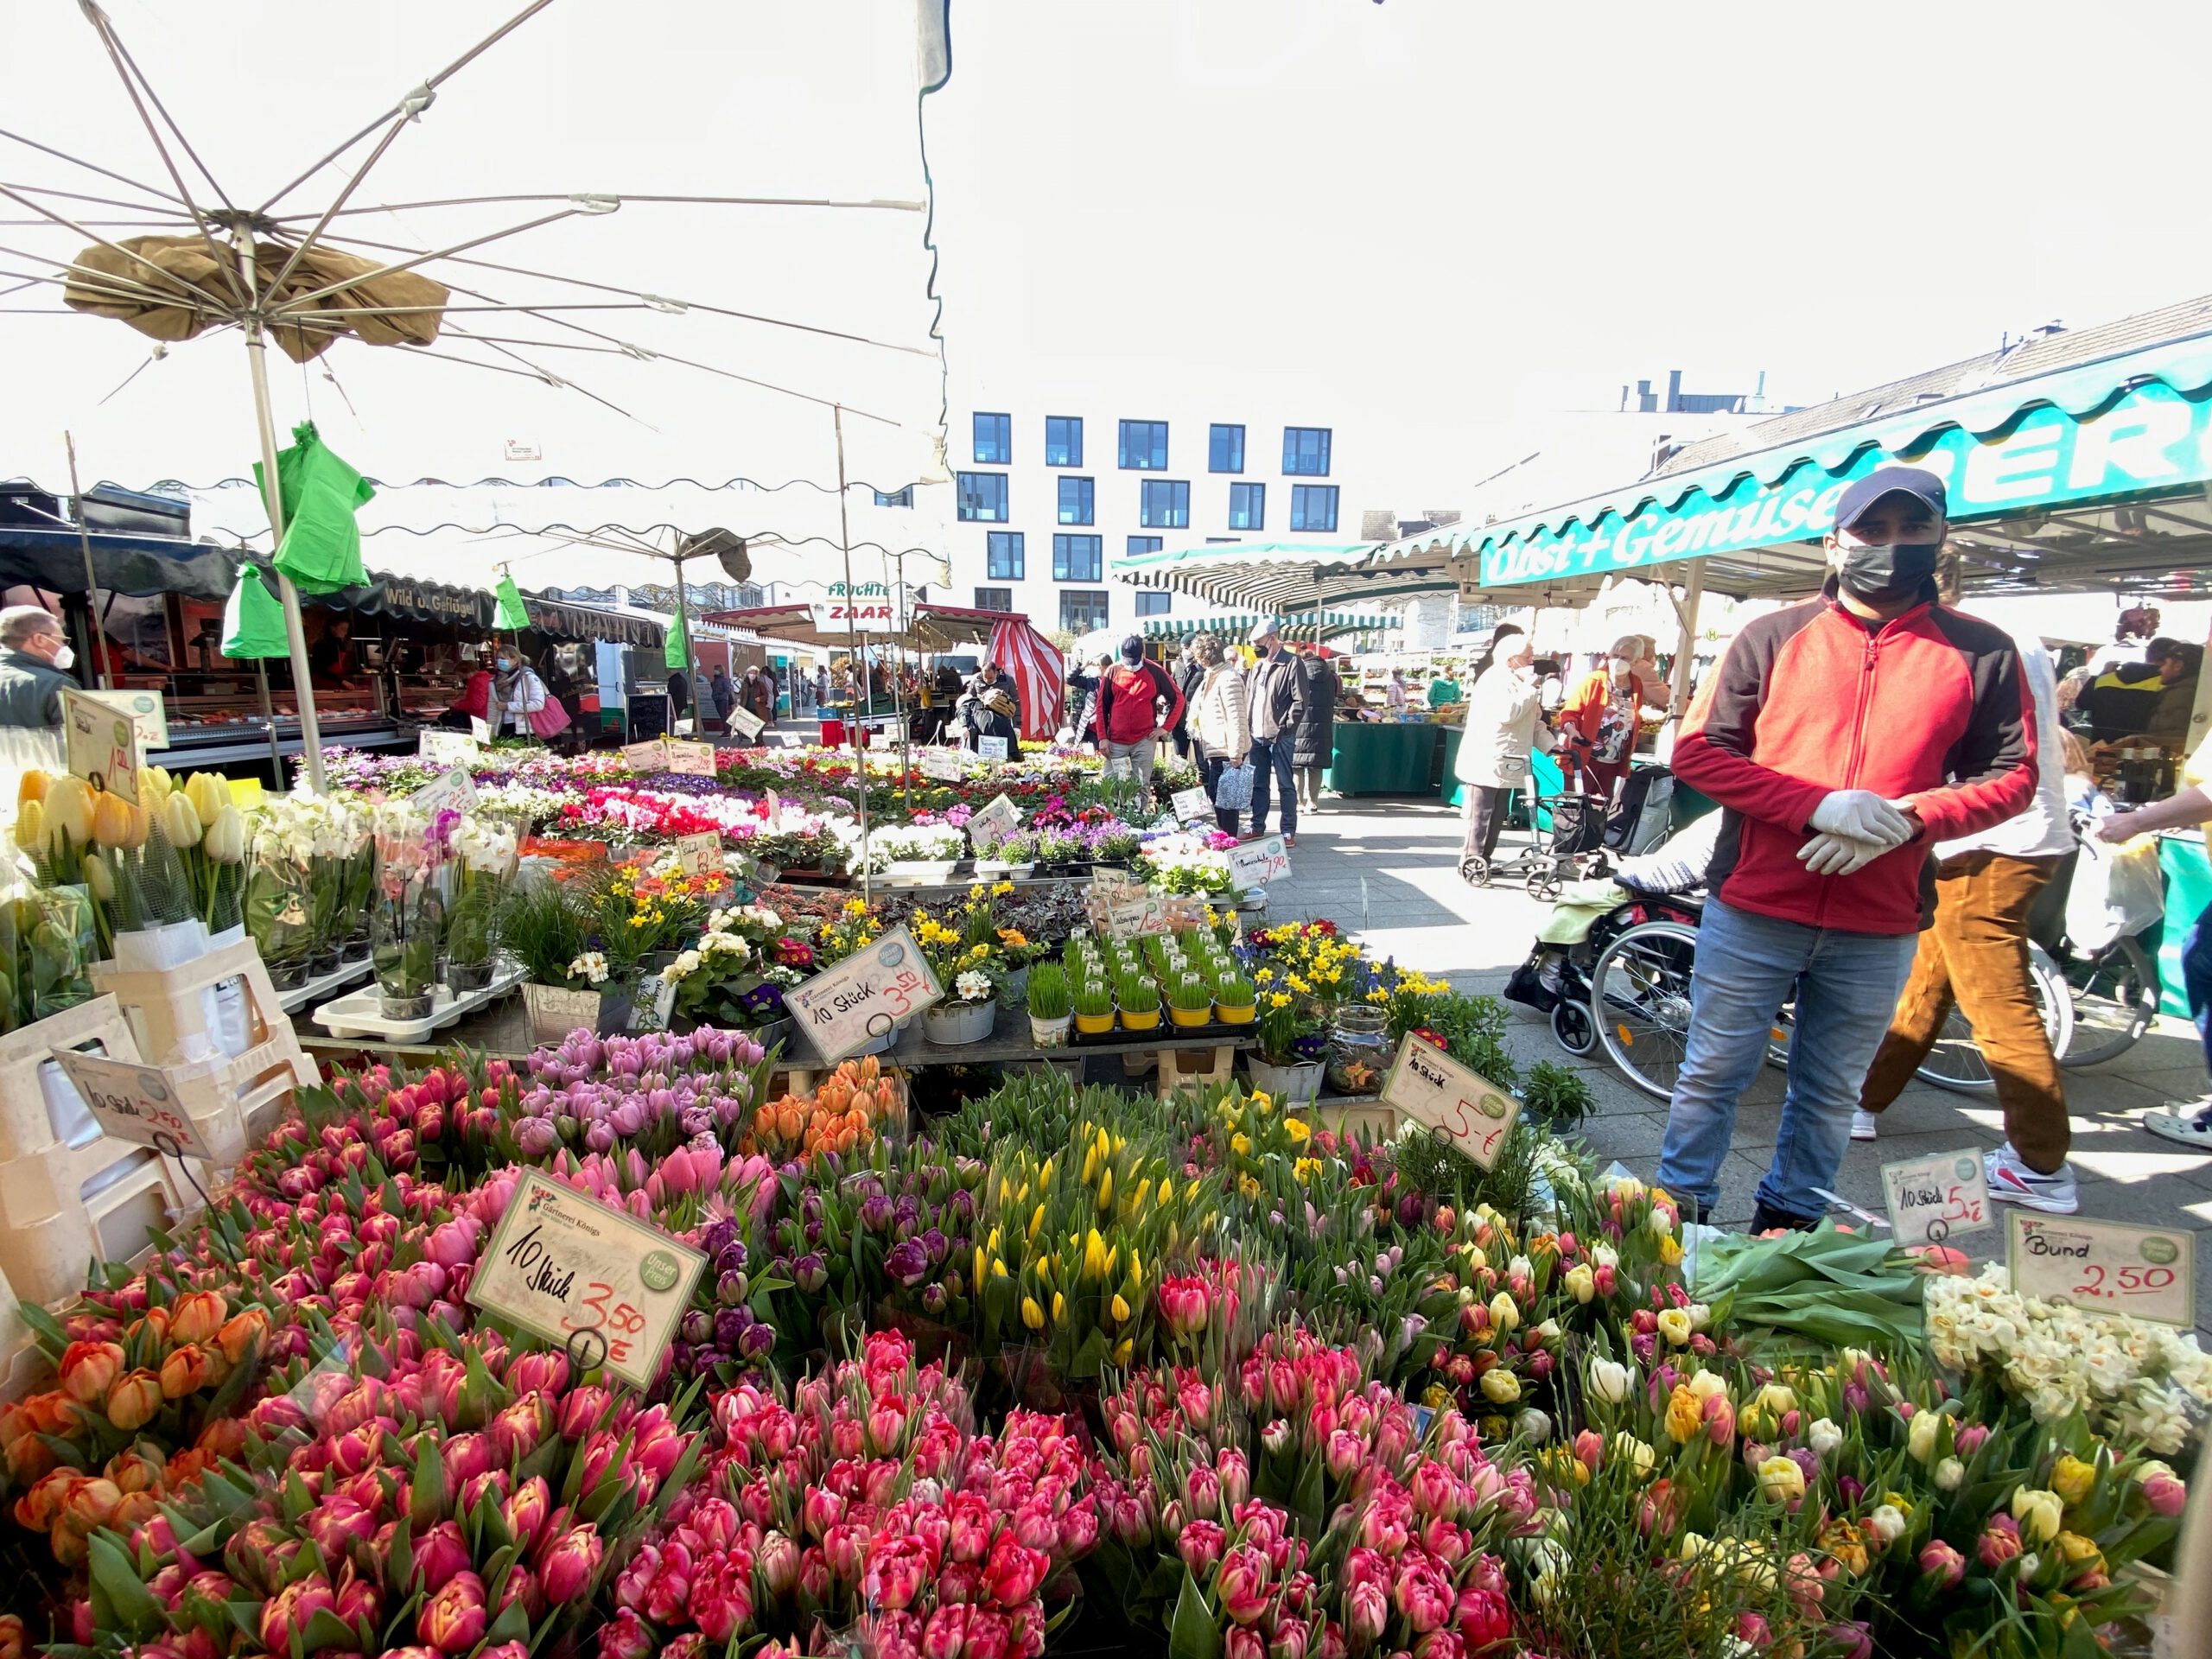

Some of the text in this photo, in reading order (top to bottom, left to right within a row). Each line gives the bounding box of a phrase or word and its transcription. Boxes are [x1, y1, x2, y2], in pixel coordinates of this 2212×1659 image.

[385, 588, 413, 607] Wild
[432, 595, 474, 619] Geflügel
[830, 607, 893, 619] ZAAR
[812, 982, 876, 1025] 10 Stück
[1408, 1058, 1446, 1089] 10 Stück
[84, 1081, 106, 1109] 10
[1900, 1186, 1916, 1210] 10
[543, 1203, 576, 1224] Gärtnerei
[575, 1219, 601, 1236] Königs
[506, 1225, 543, 1268] 10
[2024, 1236, 2089, 1258] Bund
[645, 1268, 667, 1286] Preis
[646, 1254, 677, 1276] Unser
